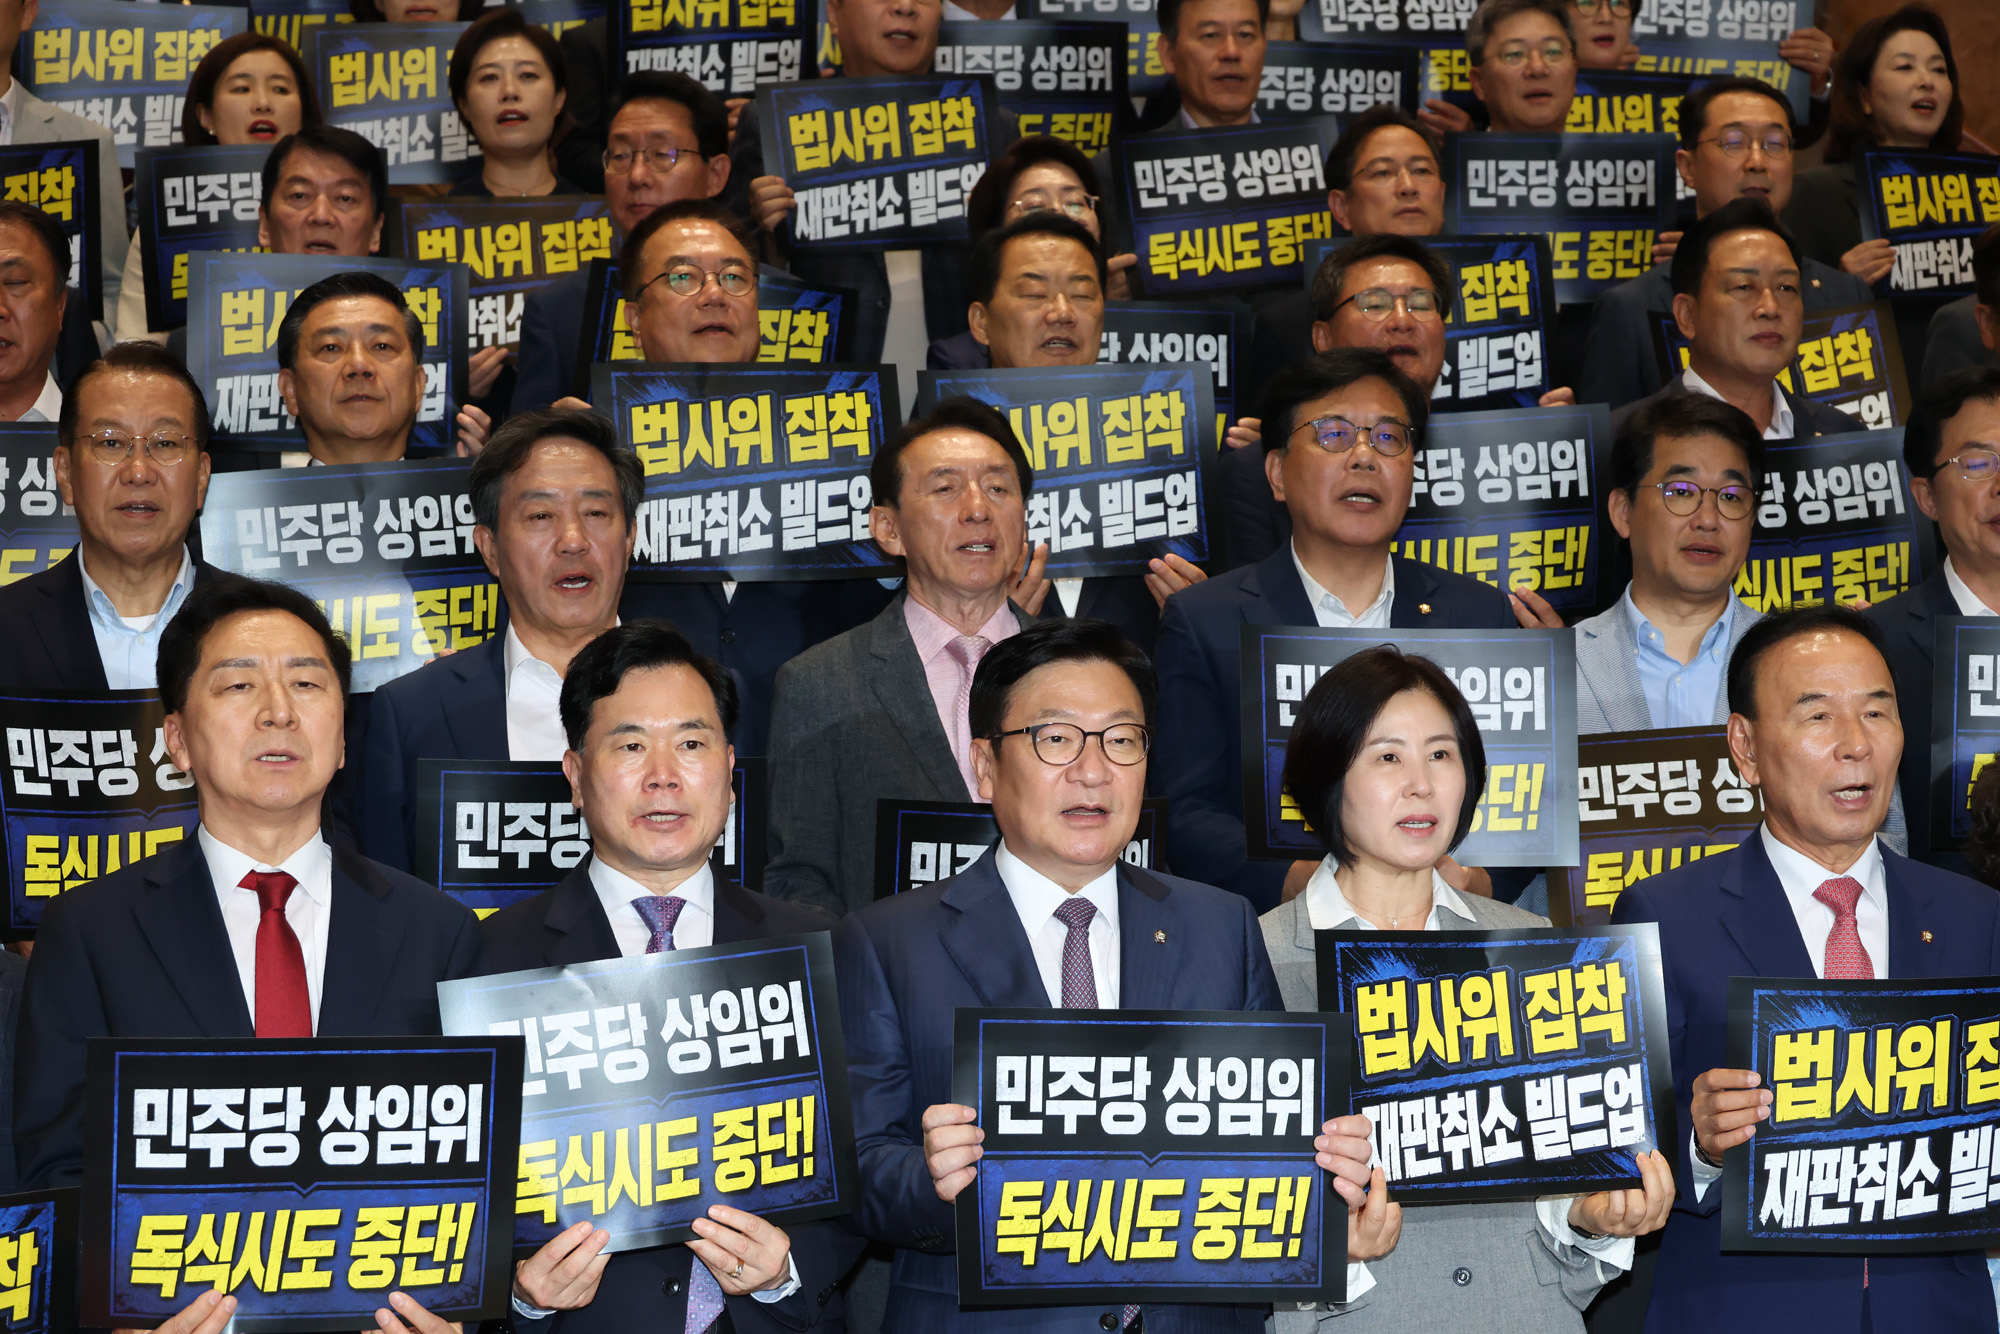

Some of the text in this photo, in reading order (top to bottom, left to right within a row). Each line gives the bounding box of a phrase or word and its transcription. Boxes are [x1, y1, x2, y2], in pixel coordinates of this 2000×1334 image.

[1717, 0, 1796, 41] 상임위
[34, 27, 144, 85] 법사위
[330, 46, 437, 107] 법사위
[731, 39, 802, 93] 빌드업
[1030, 45, 1113, 91] 상임위
[1427, 49, 1472, 91] 중단
[1253, 66, 1315, 112] 주당
[789, 96, 977, 172] 법사위 집착
[163, 172, 263, 227] 민주당
[794, 175, 905, 240] 재판취소
[1133, 144, 1326, 209] 민주당 상임위
[1466, 160, 1558, 207] 민주당
[1564, 160, 1656, 207] 상임위
[1881, 173, 2000, 229] 법사위 집
[541, 217, 613, 274] 집착
[1149, 221, 1262, 280] 독식시도
[1586, 229, 1655, 280] 중단!
[403, 287, 442, 346] 착
[1461, 260, 1530, 322] 집착
[757, 309, 829, 363] 집착
[1458, 330, 1542, 399] 빌드업
[1798, 328, 1875, 393] 집착
[213, 373, 297, 434] 재판
[631, 391, 872, 477] 법사위 집착
[1009, 397, 1092, 471] 사위
[1102, 390, 1186, 463] 집착
[1474, 439, 1589, 504] 상임위
[1793, 460, 1905, 525] 상임위
[235, 501, 364, 572] 민주당
[633, 488, 774, 564] 재판취소
[1025, 471, 1198, 553] 취소 빌드업
[1507, 525, 1590, 593] 중단!
[1733, 554, 1825, 613] 식시도
[1445, 666, 1546, 731] 임위
[6, 728, 140, 797] 민주당
[1578, 759, 1702, 822] 민주당
[1469, 763, 1546, 832] 단!
[456, 802, 591, 869] 민주당
[660, 980, 811, 1075] 상임위
[1357, 961, 1627, 1075] 법사위 집착
[996, 1055, 1316, 1136] 민주당 상임위
[1773, 1020, 1951, 1123] 법사위
[133, 1083, 484, 1169] 민주당 상임위
[1362, 1063, 1646, 1182] 재판취소 빌드업
[515, 1094, 815, 1224] 독식시도 중단!
[1758, 1136, 1941, 1229] 재판취소
[130, 1202, 477, 1298] 독식시도 중단!
[996, 1176, 1312, 1266] 독식시도 중단!
